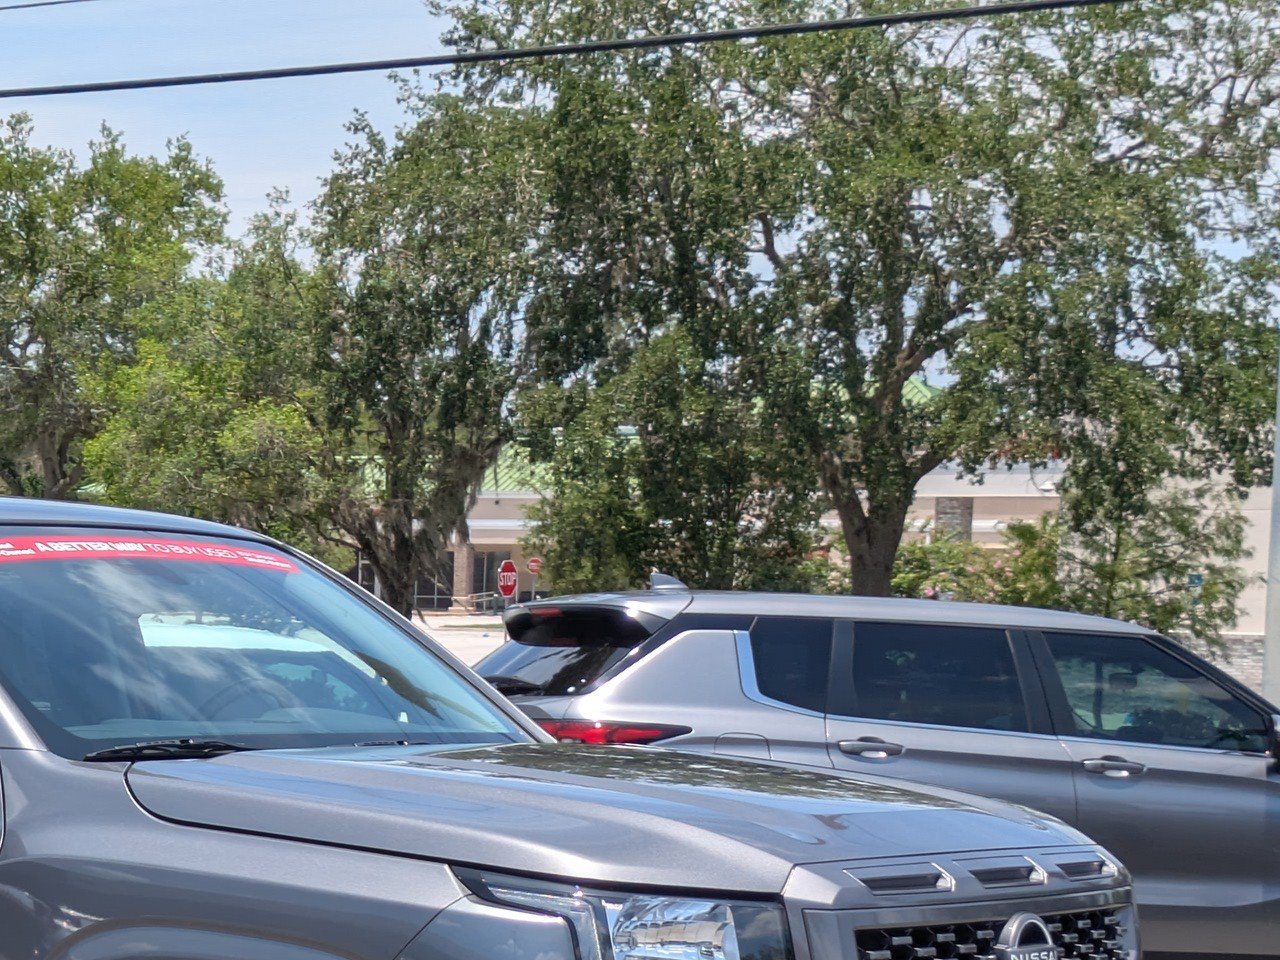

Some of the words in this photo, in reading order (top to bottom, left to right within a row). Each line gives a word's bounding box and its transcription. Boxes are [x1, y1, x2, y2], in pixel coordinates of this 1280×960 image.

[46, 541, 117, 552] BETTER
[143, 543, 171, 553] TO
[167, 544, 199, 554] BUY
[197, 548, 238, 558] USED
[499, 572, 517, 586] STOP
